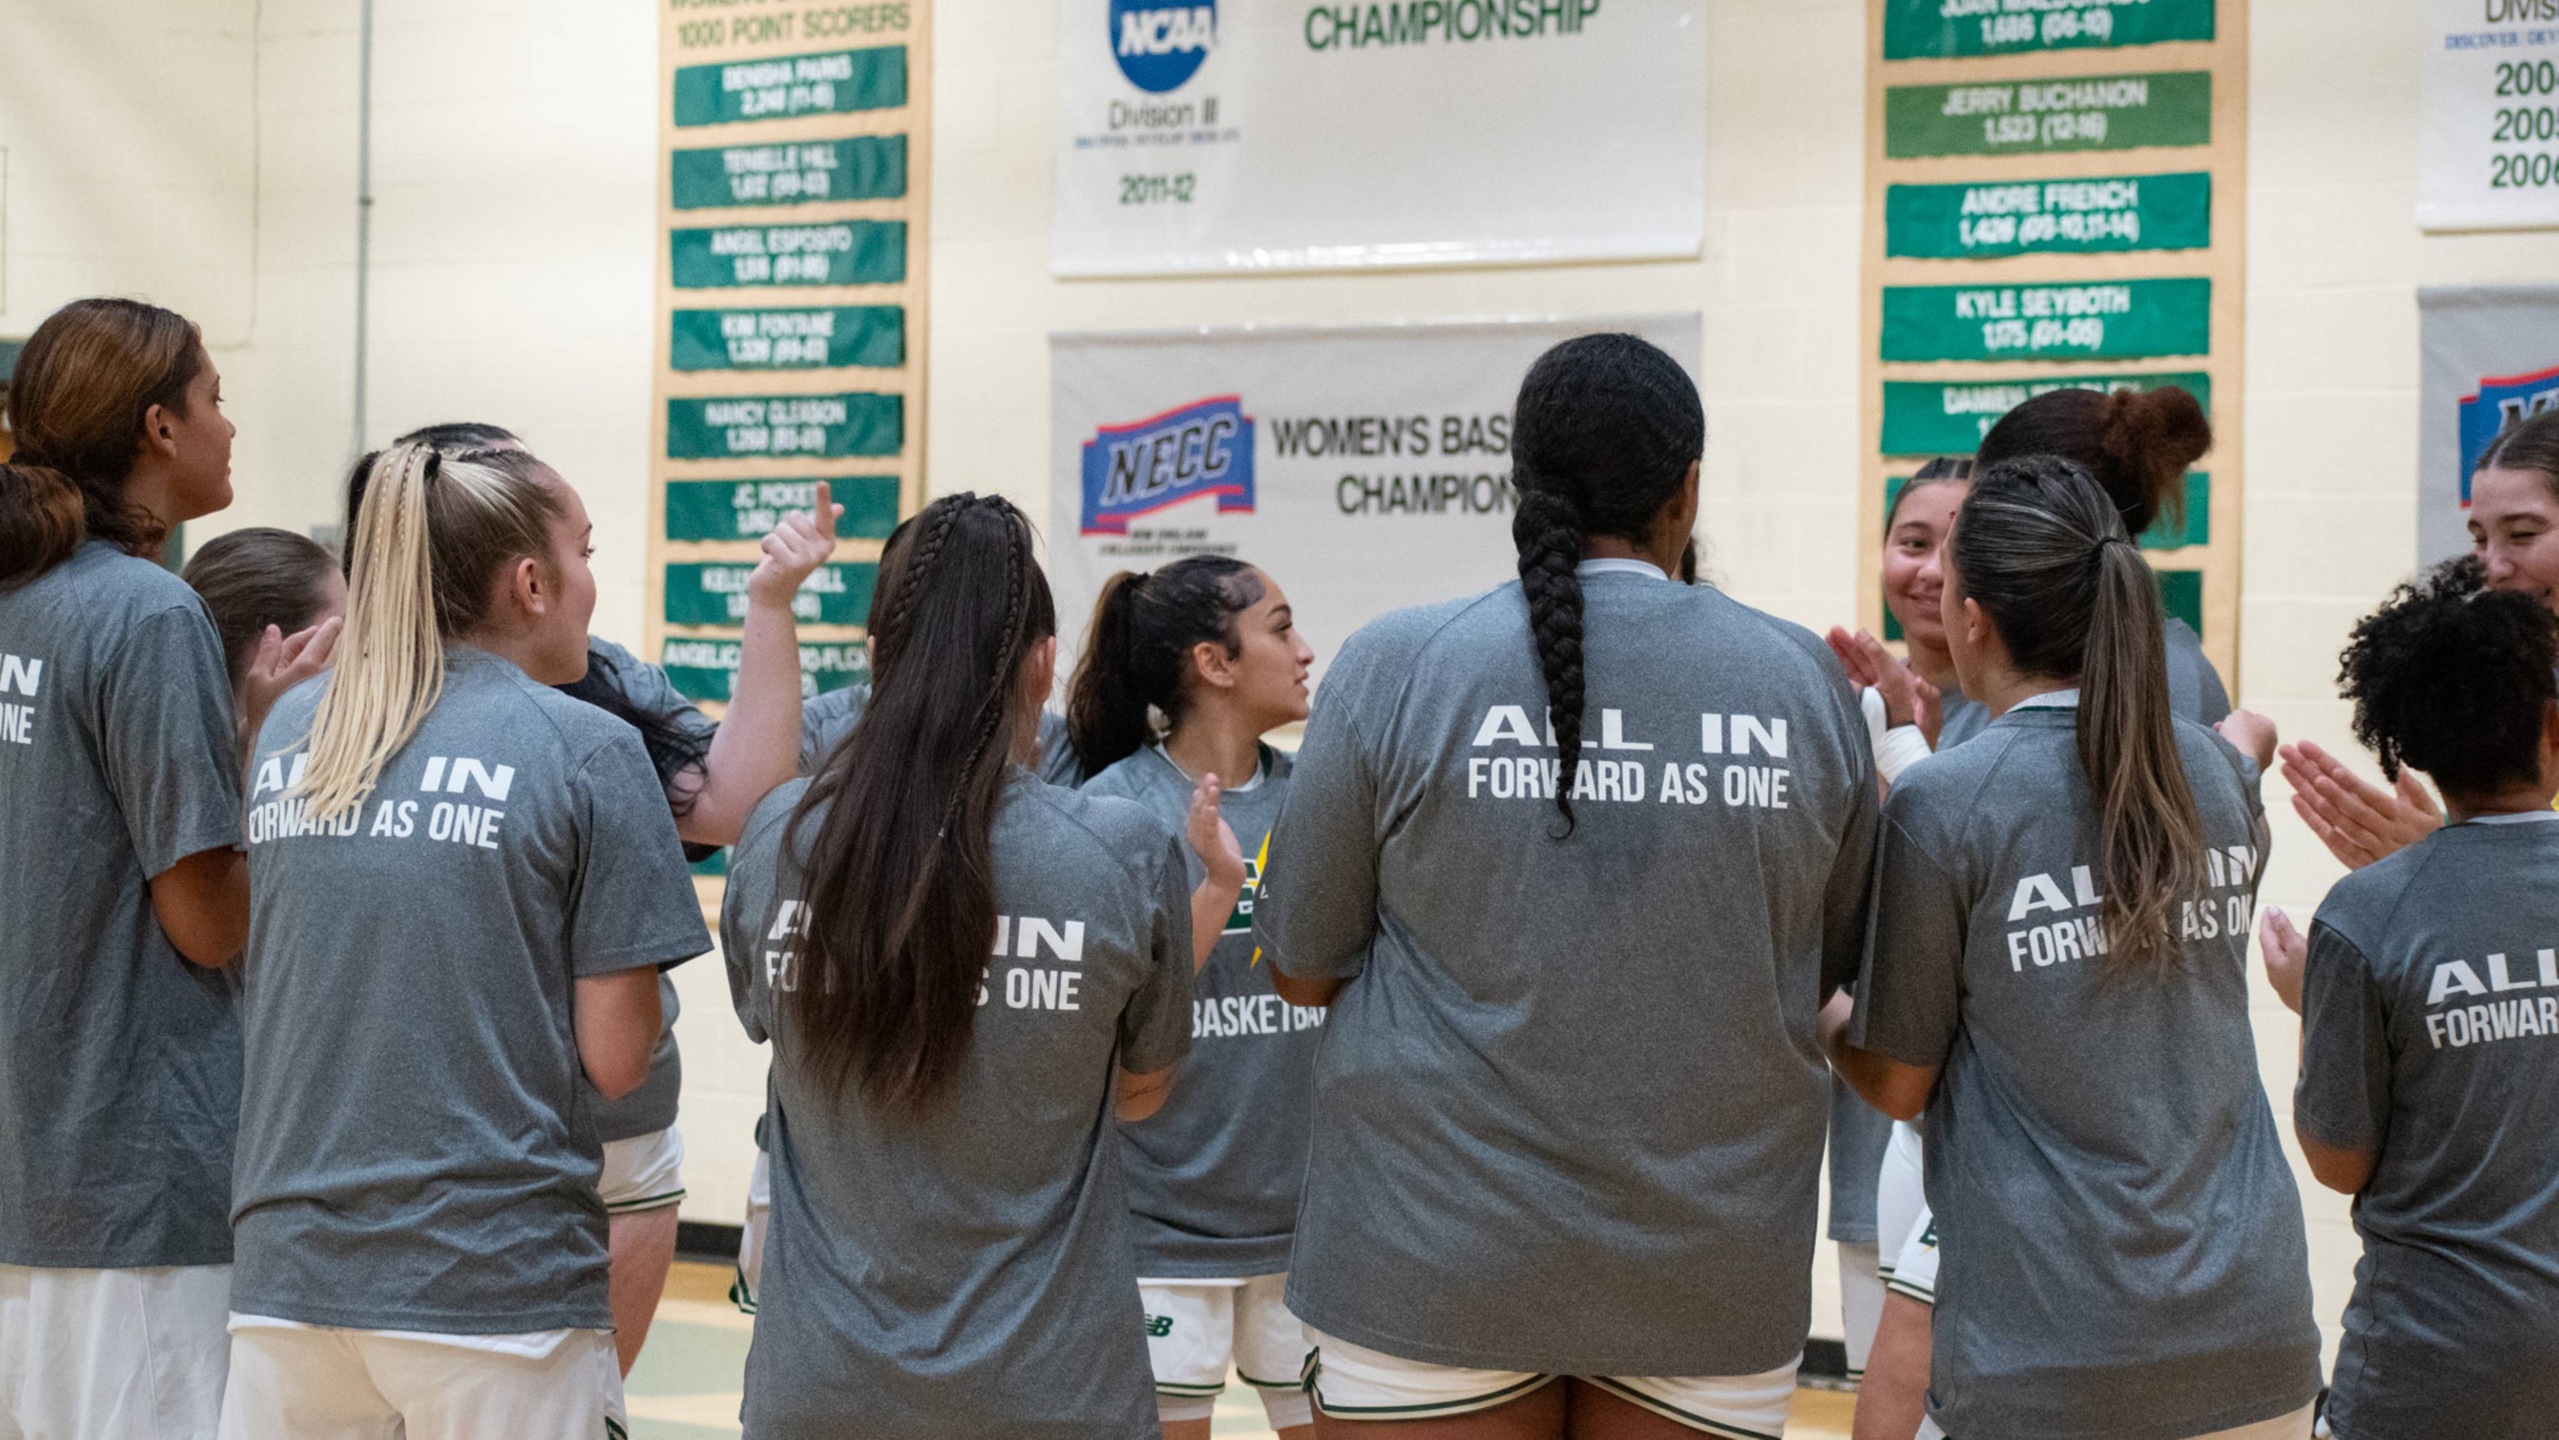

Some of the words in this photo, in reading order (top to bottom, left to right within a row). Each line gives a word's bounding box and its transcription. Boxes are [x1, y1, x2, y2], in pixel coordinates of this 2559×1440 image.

[732, 12, 795, 44] POINT
[803, 3, 910, 39] SCORERS
[1119, 7, 1219, 57] NCAA
[1305, 0, 1601, 51] CHAMPIONSHIP
[2495, 61, 2559, 96] 200
[1109, 100, 1194, 130] Division
[1942, 87, 2014, 115] JERRY
[2492, 107, 2559, 142] 200
[1961, 185, 2040, 216] ANDRE
[2044, 180, 2138, 210] FRENCH
[1955, 289, 2017, 319] KYLE
[2021, 286, 2130, 318] SEYBOTH
[1272, 415, 1430, 456] WOMEN'S
[1102, 413, 1237, 505] NECC
[1702, 712, 1788, 759] IN
[420, 756, 515, 801] IN
[1468, 757, 1646, 802] FORWARD
[1660, 762, 1709, 805] AS
[1723, 765, 1791, 810] ONE
[370, 800, 419, 837] AS
[428, 802, 505, 849] ONE
[1006, 967, 1083, 1011] ONE
[2425, 996, 2559, 1049] FORWAR
